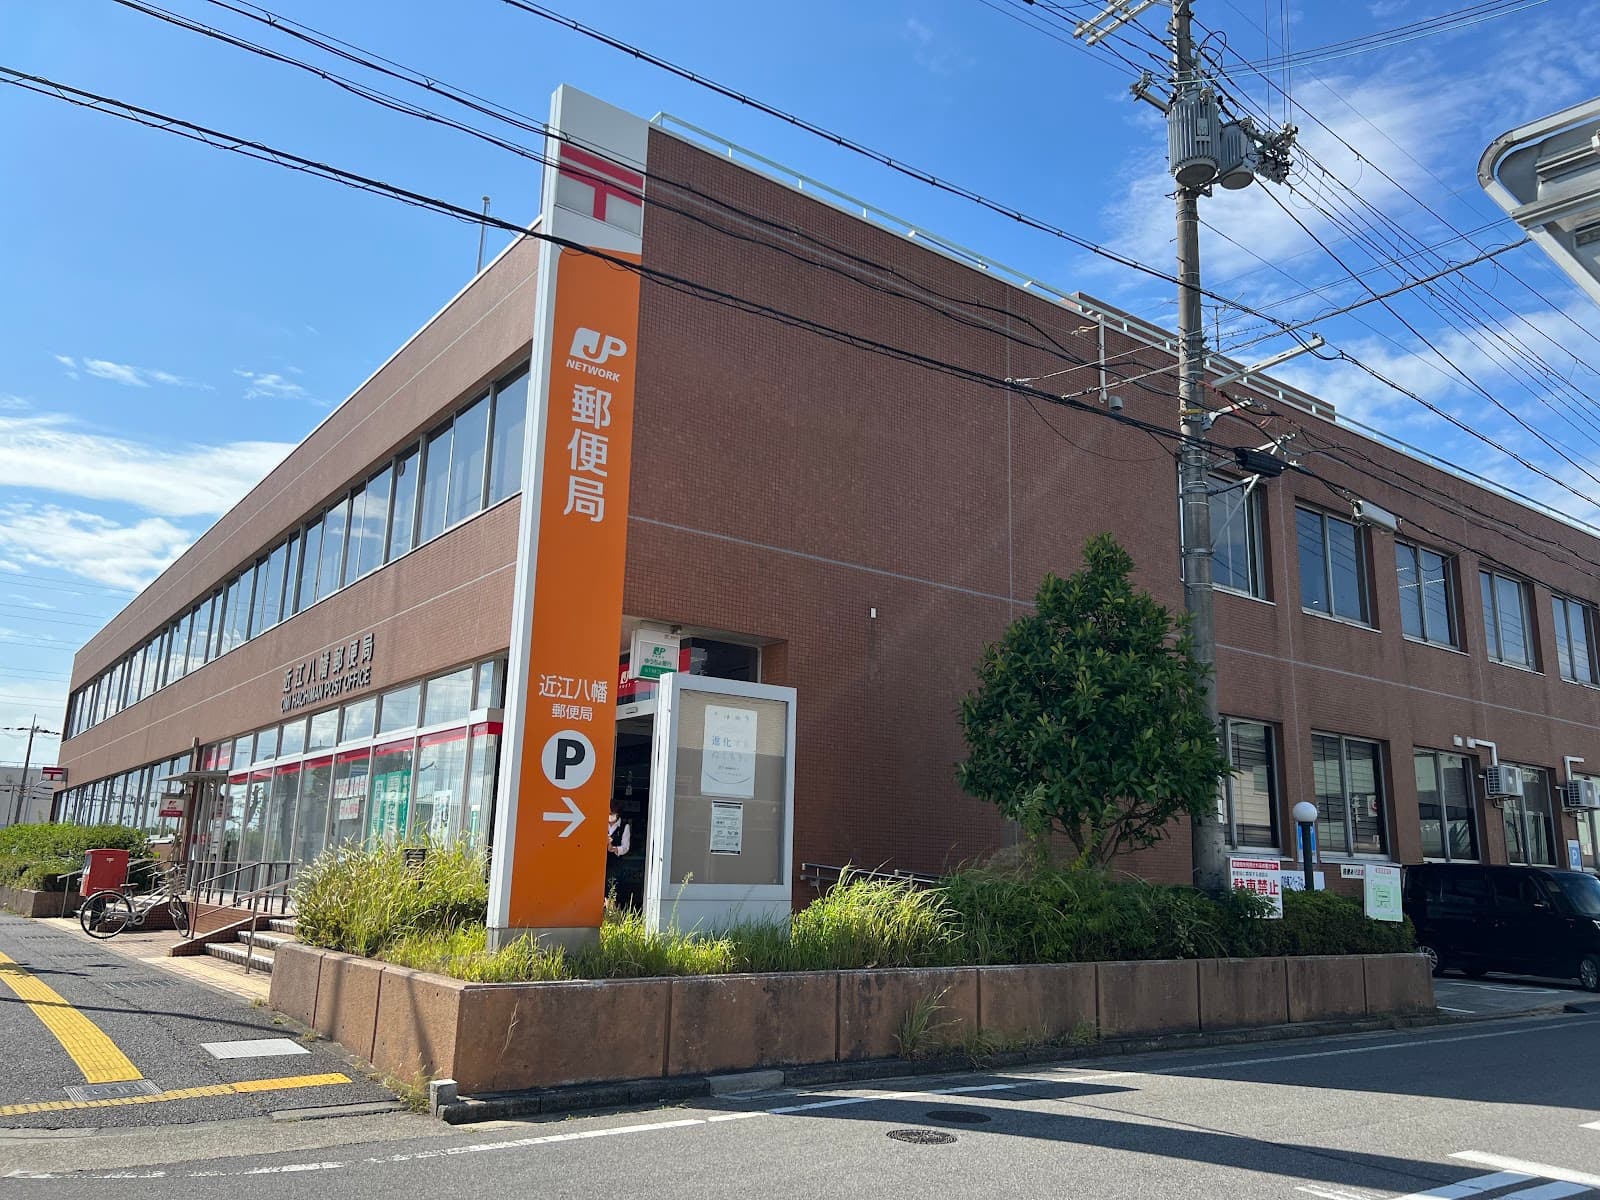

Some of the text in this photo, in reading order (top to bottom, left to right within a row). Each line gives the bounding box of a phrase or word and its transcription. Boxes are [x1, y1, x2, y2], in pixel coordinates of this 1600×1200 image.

[566, 359, 620, 382] NETWORK
[564, 384, 612, 522] 郵便局
[283, 632, 374, 693] 近江八幡郵便局
[539, 674, 608, 704] 近江八幡
[552, 703, 593, 722] 郵便局
[555, 738, 586, 780] P
